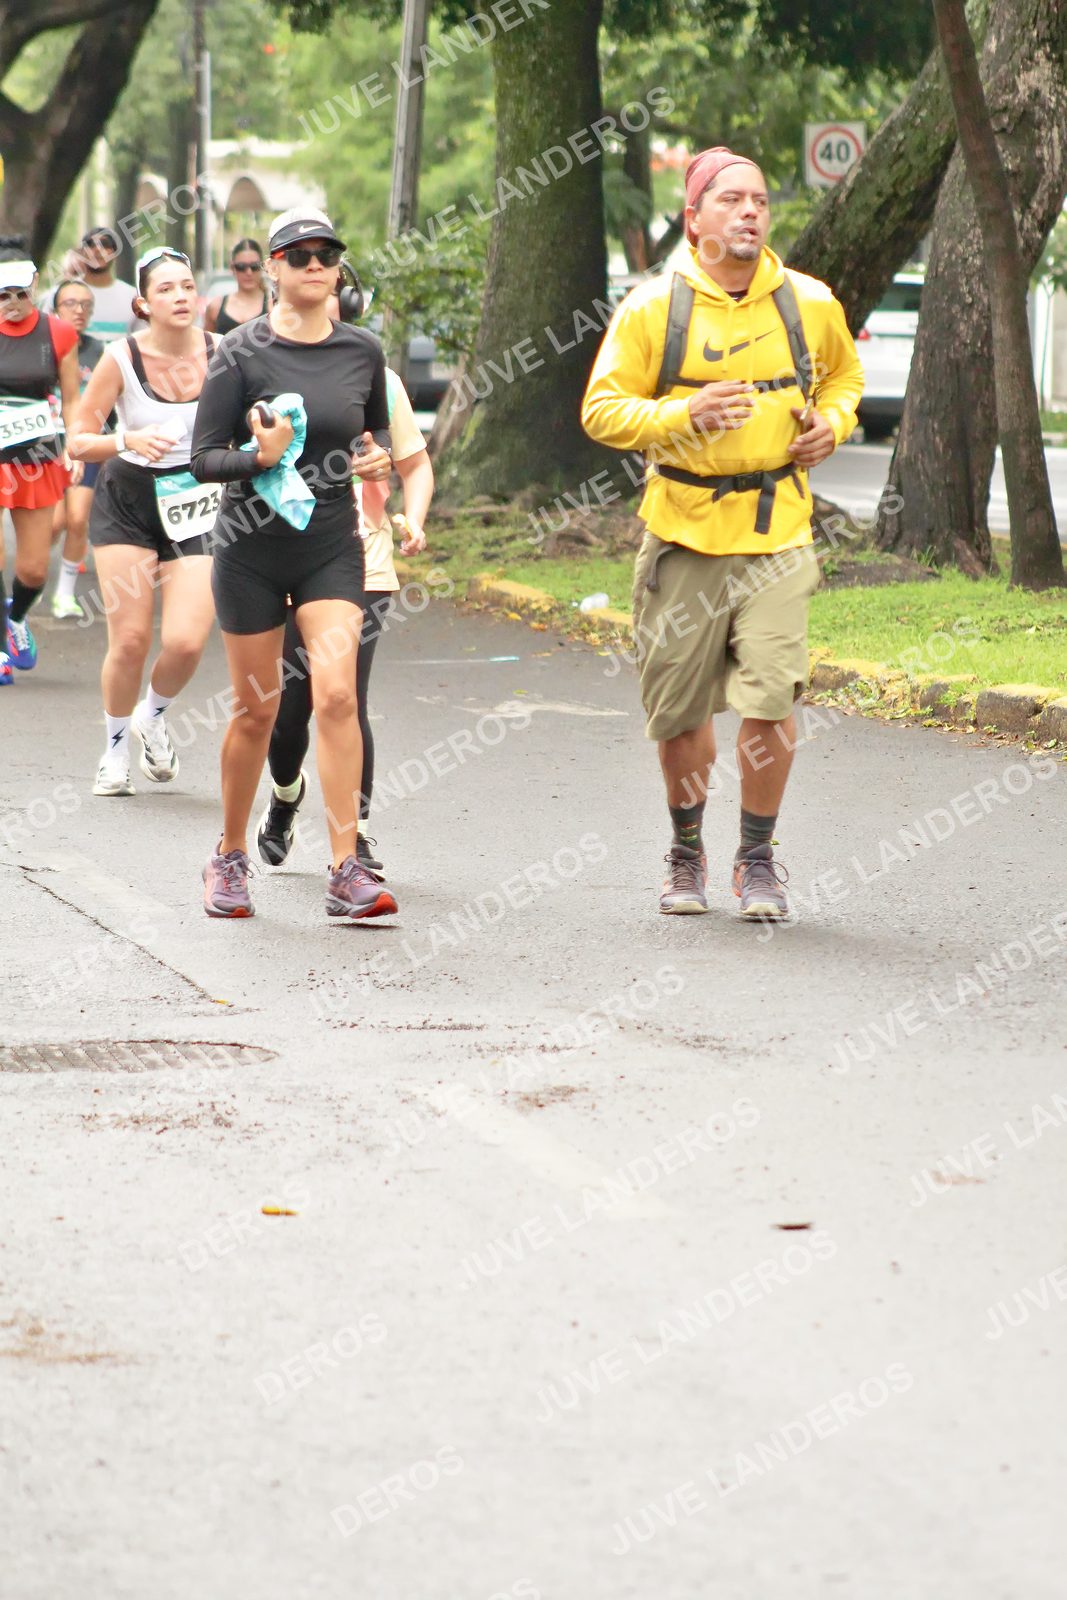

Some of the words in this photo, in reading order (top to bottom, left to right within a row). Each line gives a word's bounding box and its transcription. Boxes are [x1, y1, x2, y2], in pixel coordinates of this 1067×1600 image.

[820, 140, 850, 163] 40
[0, 414, 47, 439] 3550
[167, 490, 221, 525] 6723
